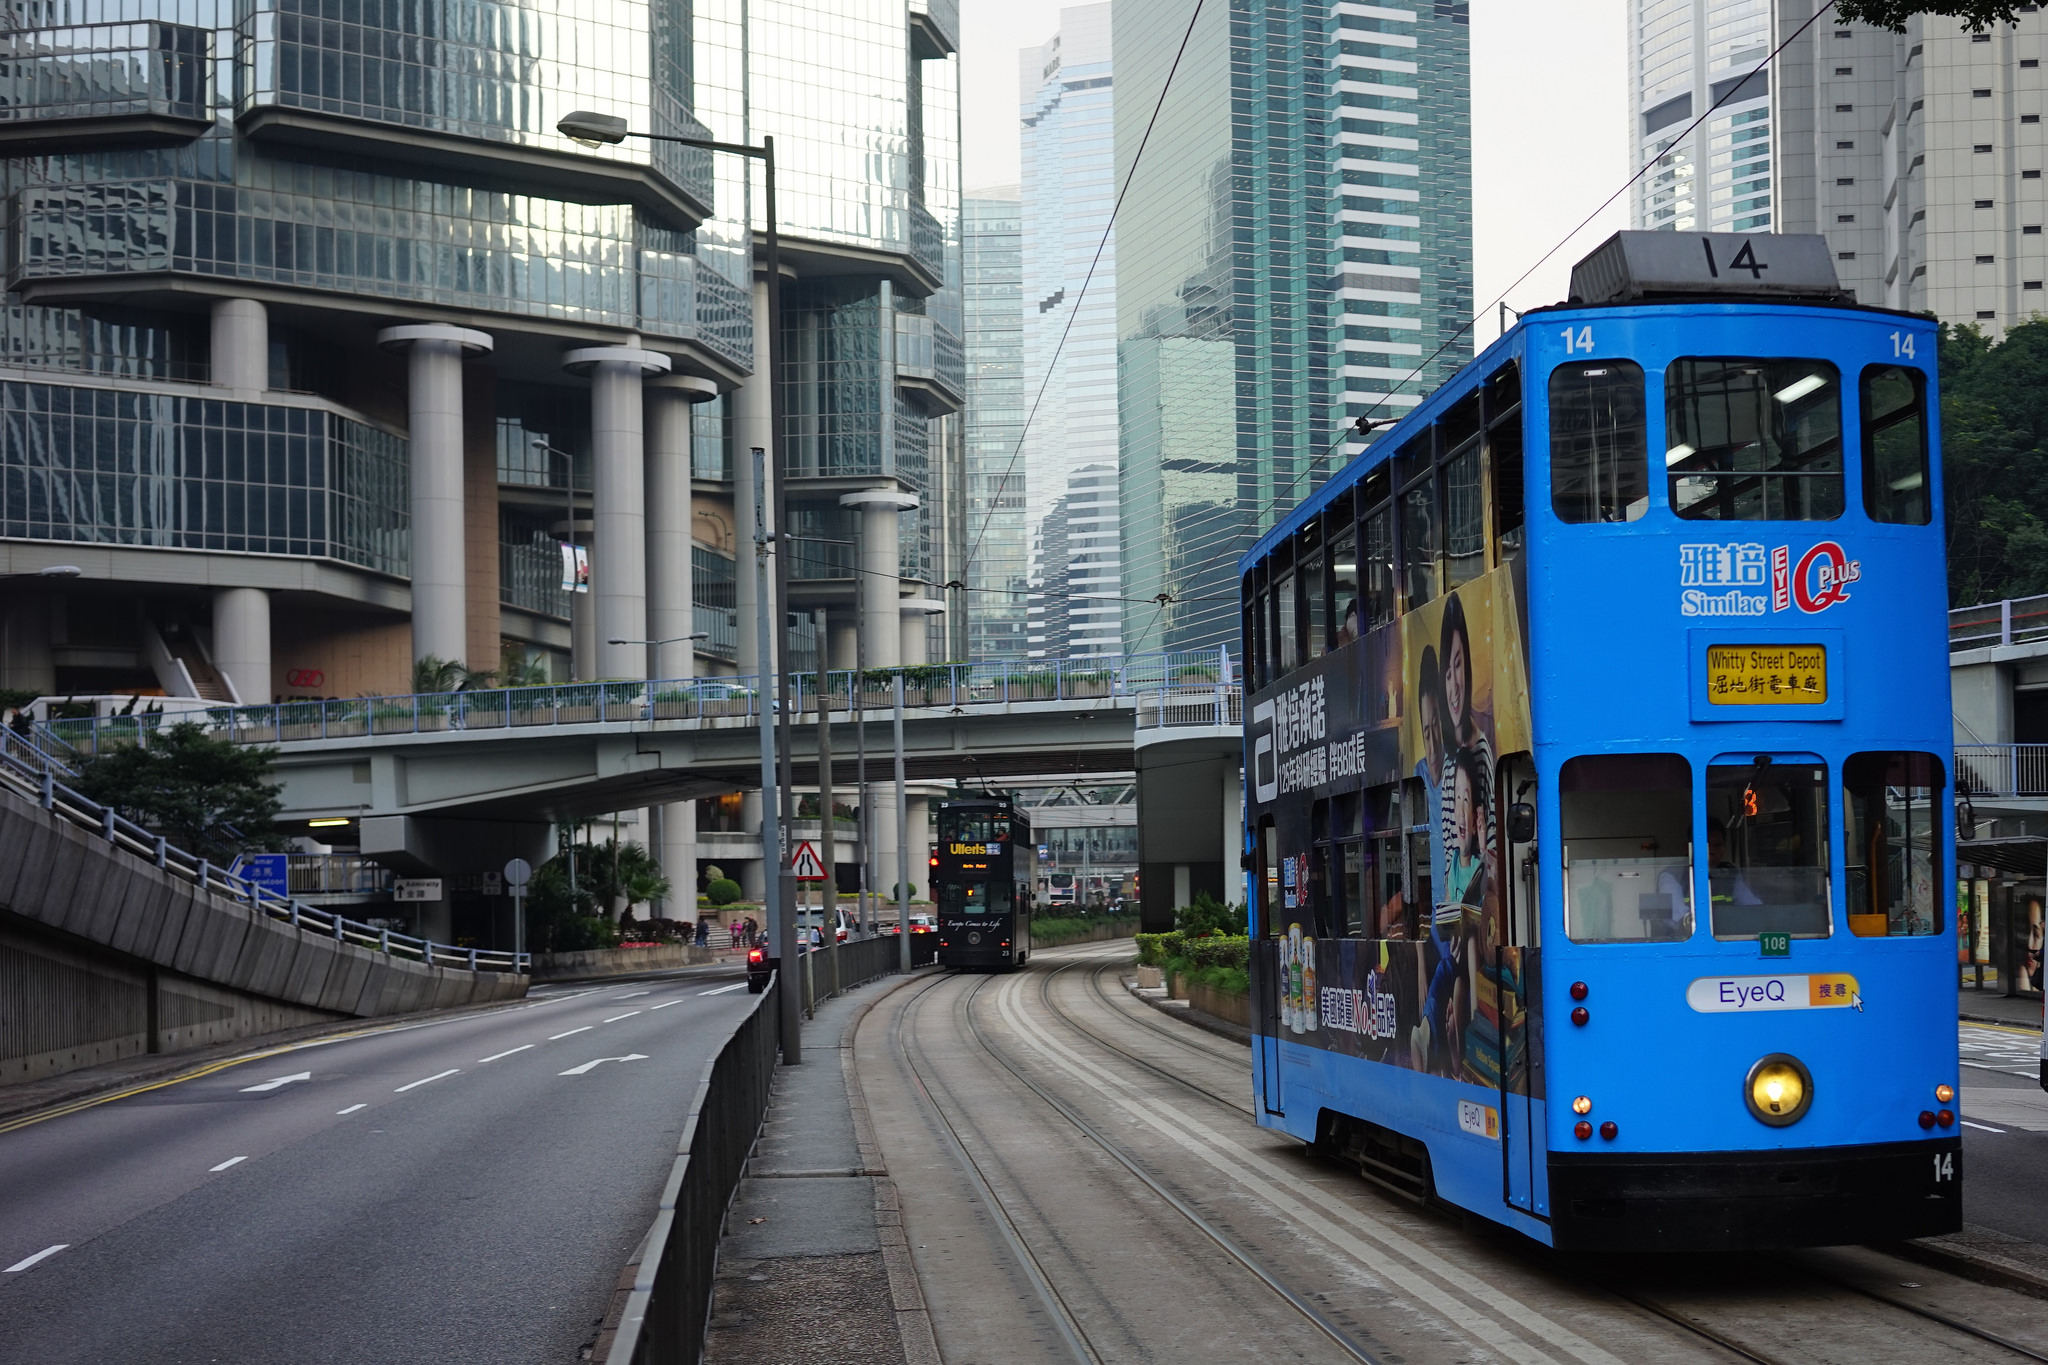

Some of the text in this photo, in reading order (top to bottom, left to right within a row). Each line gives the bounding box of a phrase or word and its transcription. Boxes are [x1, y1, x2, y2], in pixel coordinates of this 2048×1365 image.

[1702, 237, 1768, 279] 14
[1560, 325, 1595, 354] 14
[1889, 331, 1915, 359] 14
[1680, 543, 1766, 586] 雅培
[1771, 545, 1790, 613] EYE
[1818, 560, 1861, 589] PLUS
[1681, 589, 1767, 616] Similac
[1711, 651, 1821, 672] Whitty Street Depot
[1712, 674, 1821, 694] 屈地街電車廠
[1276, 674, 1326, 754] 雅培承諾
[950, 843, 986, 855] Ulferts
[406, 880, 439, 888] Admiralty
[1763, 937, 1786, 950] 108
[1719, 980, 1785, 1007] EyeQ
[1464, 1104, 1481, 1129] EyeQ
[1933, 1152, 1954, 1182] 14
